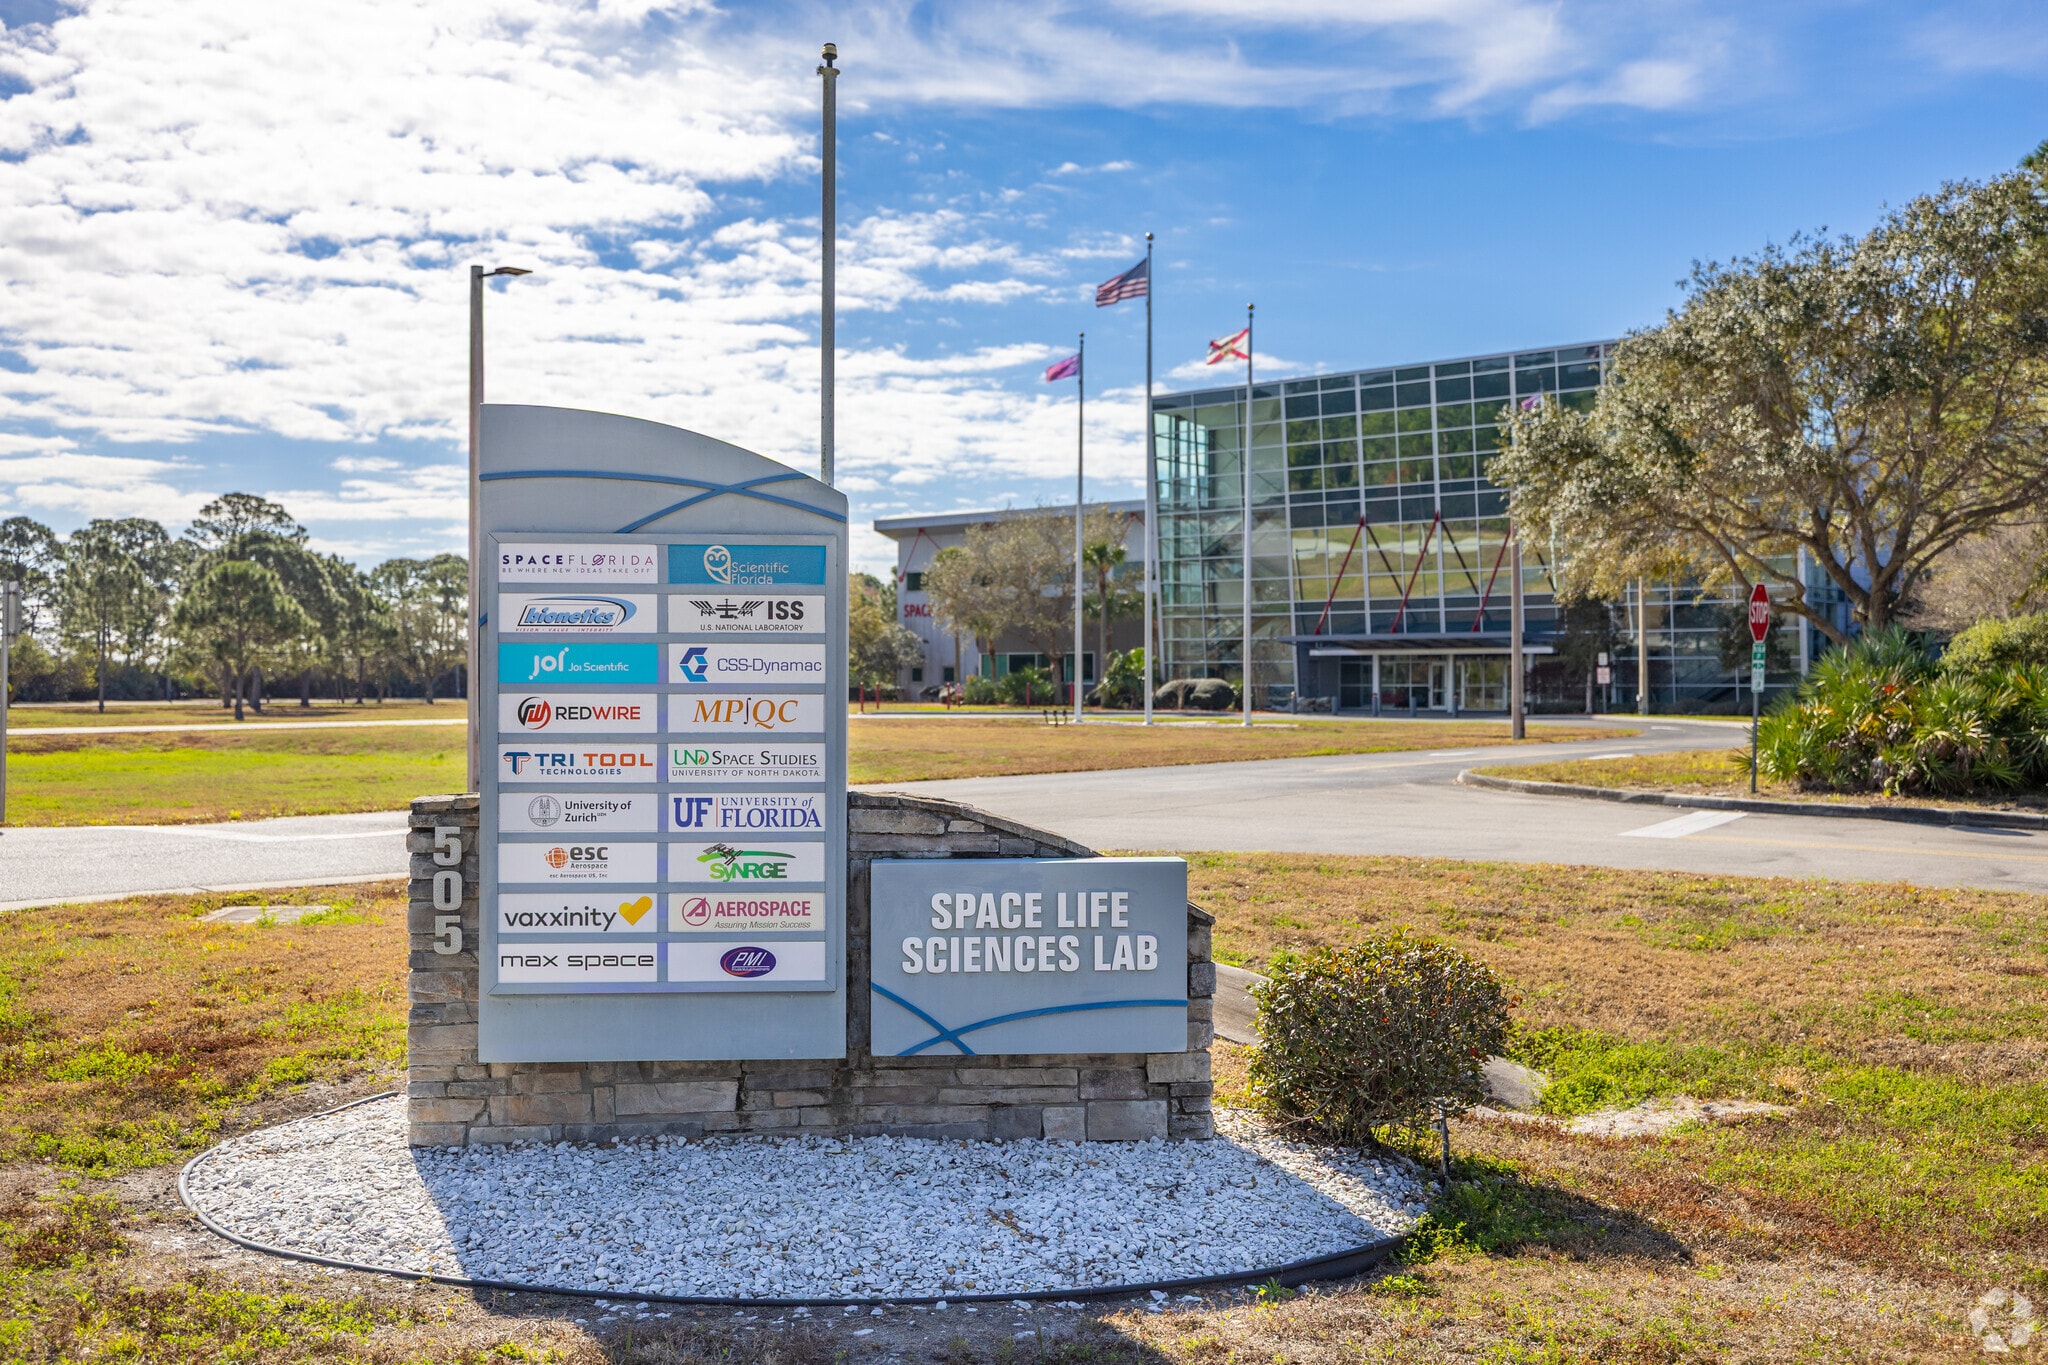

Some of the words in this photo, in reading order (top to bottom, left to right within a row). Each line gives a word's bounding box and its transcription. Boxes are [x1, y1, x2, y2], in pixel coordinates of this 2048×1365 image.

[731, 562, 789, 573] Scientific
[731, 574, 773, 584] Florida
[524, 607, 615, 624] bionetics
[767, 601, 804, 620] ISS
[1751, 601, 1768, 624] STOP
[583, 662, 628, 671] Scientific
[718, 659, 821, 674] CSS-Dynamac
[556, 706, 640, 720] REDWIRE
[535, 753, 574, 766] TRI
[583, 753, 653, 766] TOOL
[565, 801, 618, 812] University
[621, 801, 631, 811] of
[721, 797, 798, 806] UNIVERSITY
[802, 797, 813, 808] of
[674, 798, 712, 827] UF
[721, 808, 821, 827] FLORIDA
[571, 846, 608, 861] esc
[715, 901, 811, 917] AEROSPACE
[931, 892, 1042, 929] SPACE
[1057, 892, 1128, 928] LIFE
[505, 906, 617, 931] vaxxinity
[715, 921, 747, 930] Assuring
[501, 954, 558, 968] max
[568, 955, 654, 970] space
[732, 952, 767, 966] PMI
[902, 936, 1080, 974] SCIENCES
[1094, 935, 1157, 971] LAB
